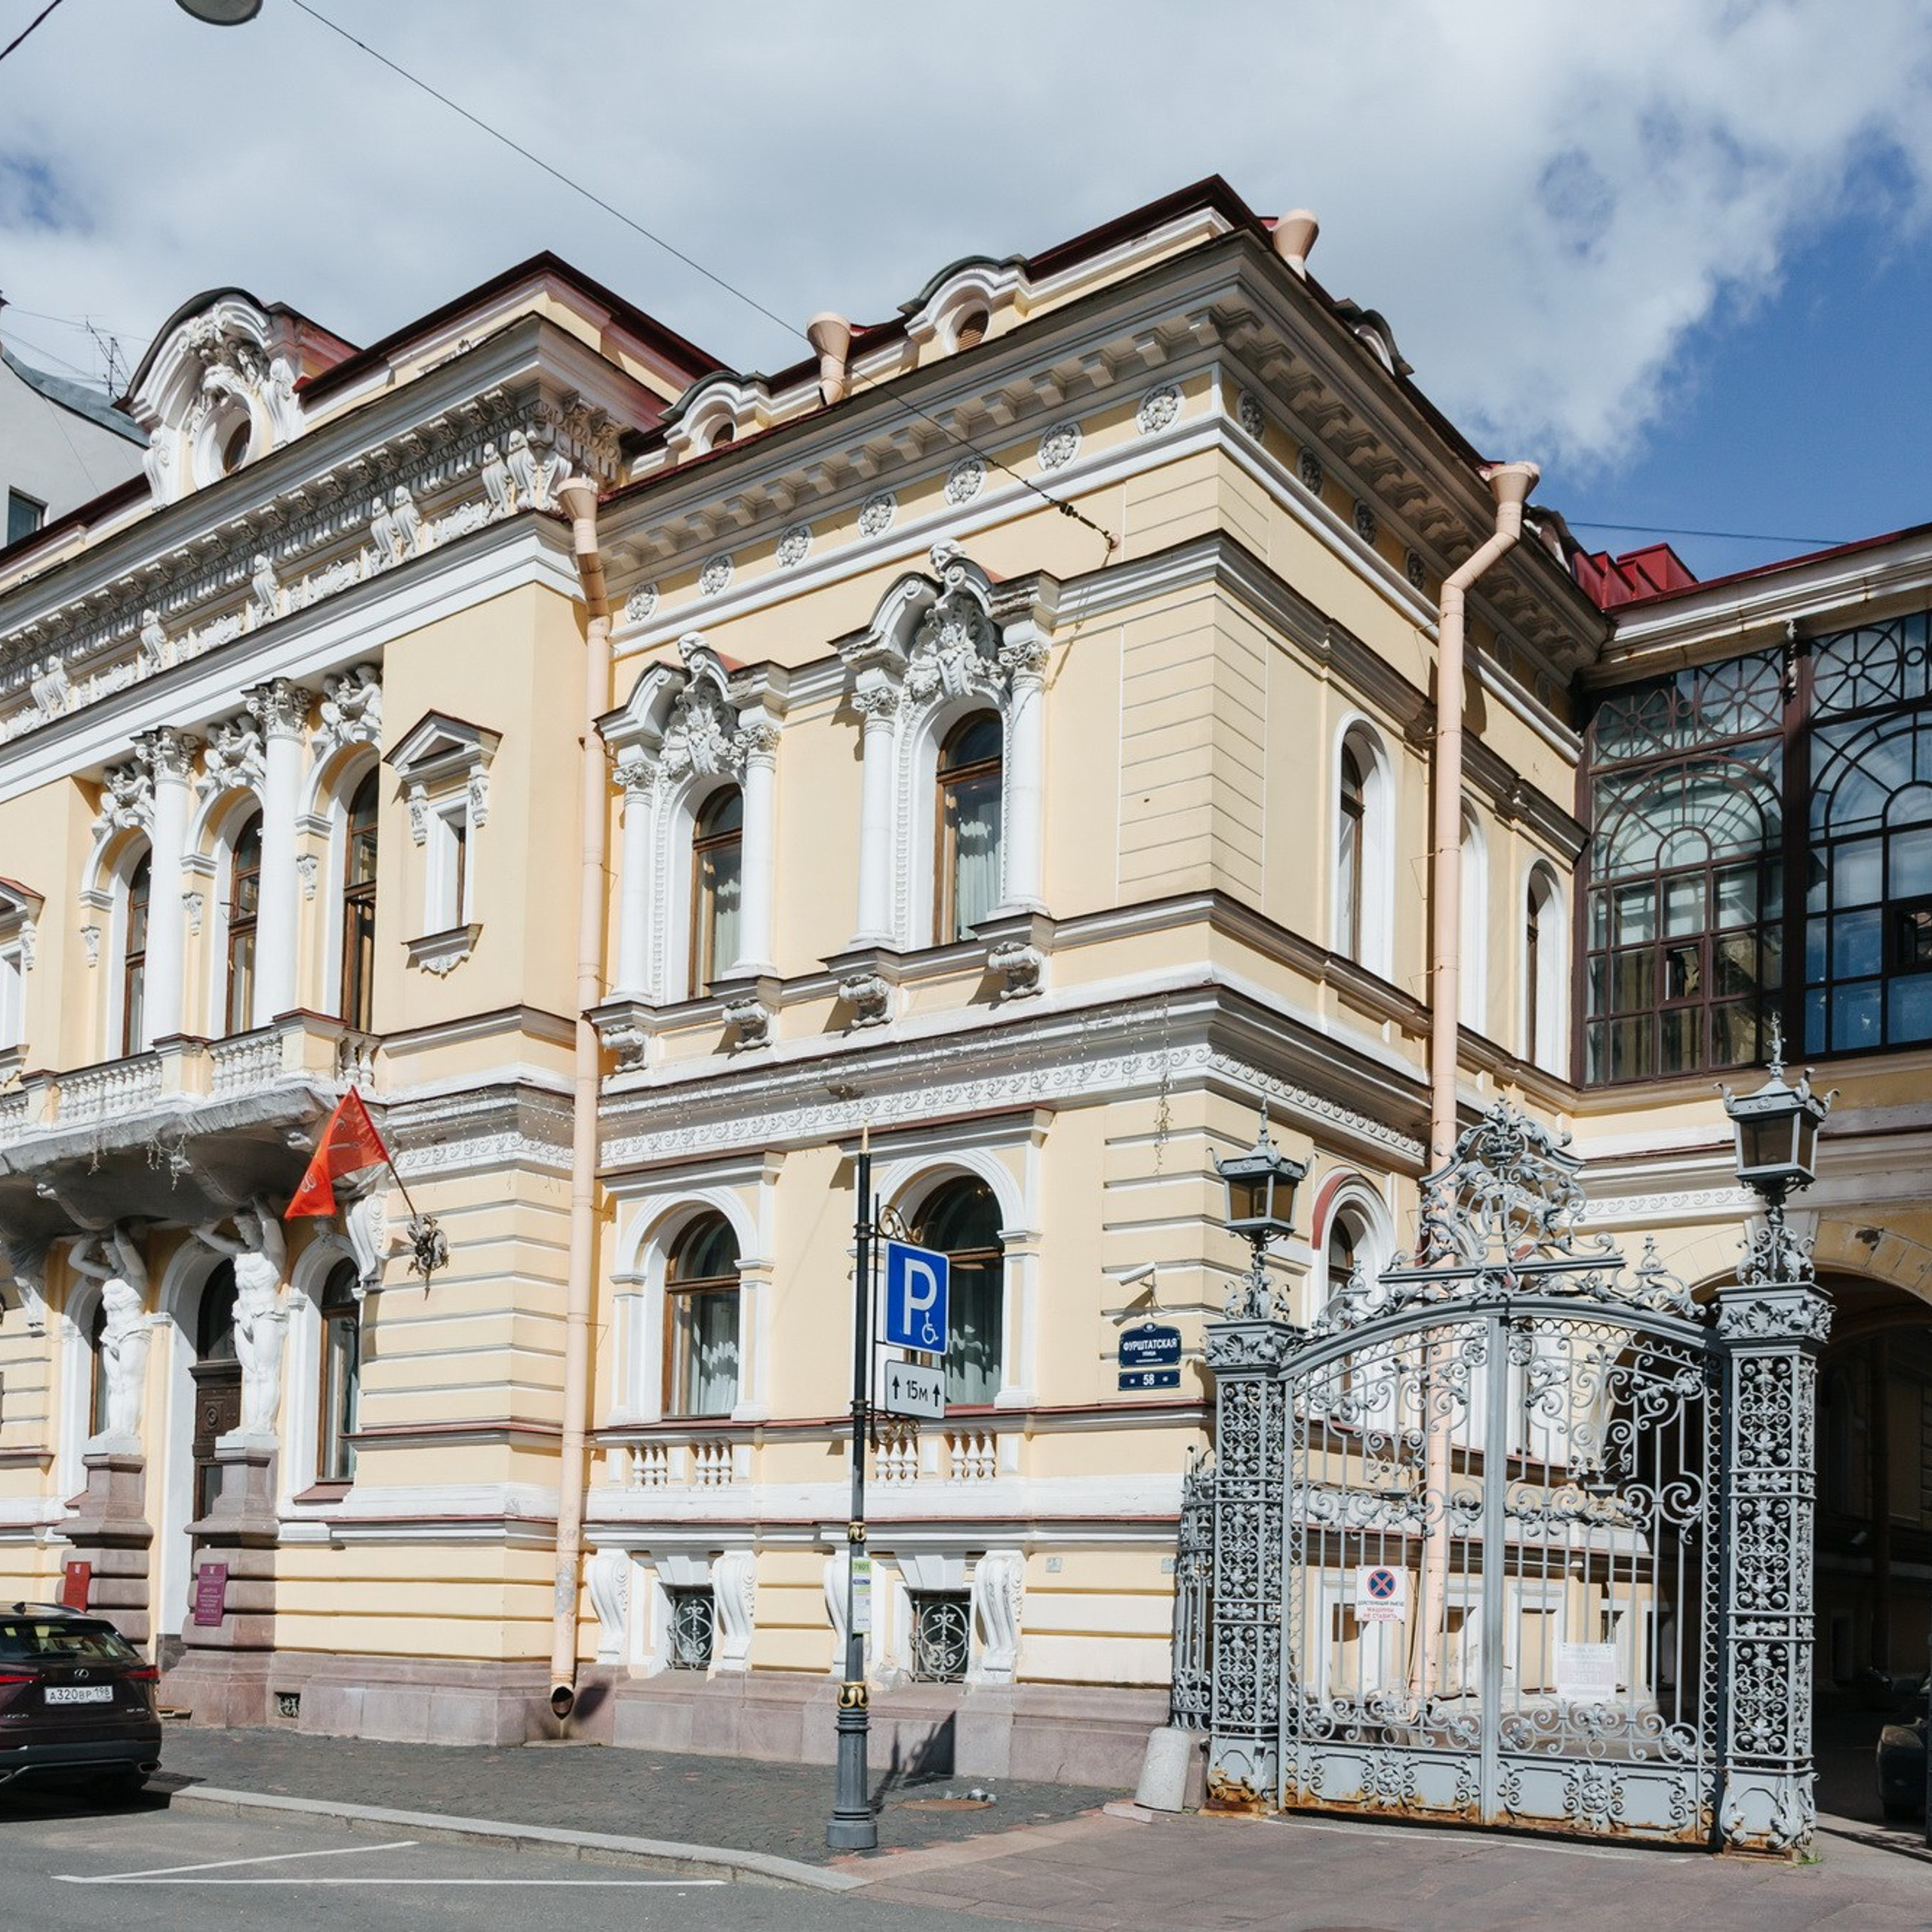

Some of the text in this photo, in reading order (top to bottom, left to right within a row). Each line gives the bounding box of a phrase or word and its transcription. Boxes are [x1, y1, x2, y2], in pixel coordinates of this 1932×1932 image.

[903, 1258, 937, 1335] P
[1123, 1338, 1177, 1351] ФУРШТАТСКАЯ
[1143, 1373, 1155, 1386] 58
